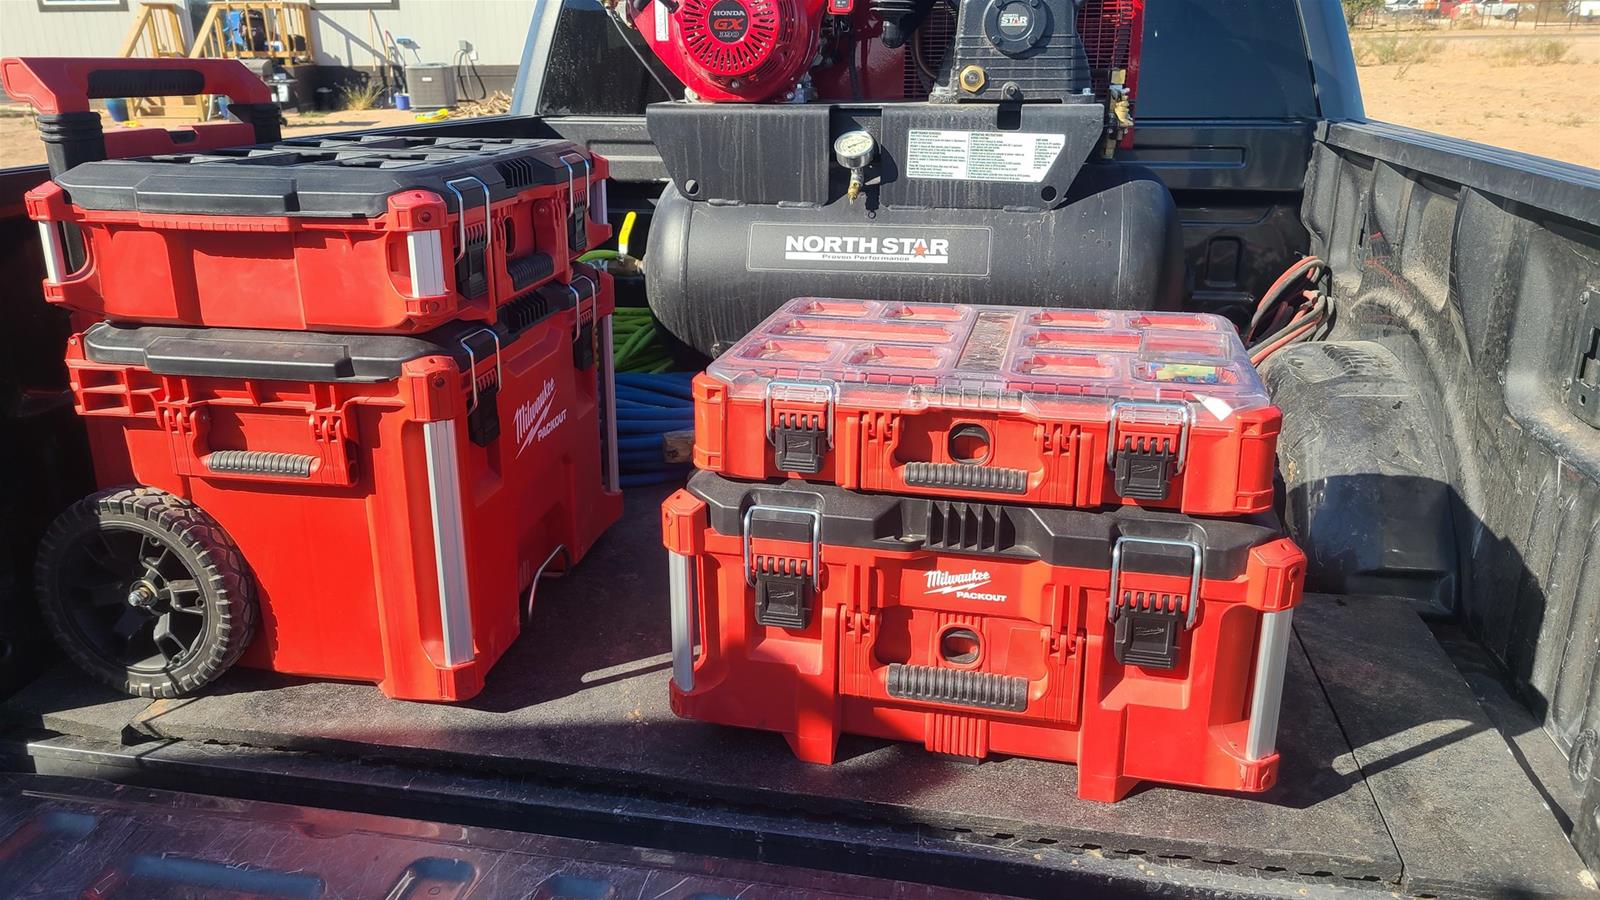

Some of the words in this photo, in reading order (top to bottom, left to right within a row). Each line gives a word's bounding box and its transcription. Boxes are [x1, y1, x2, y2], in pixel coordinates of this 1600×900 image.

[713, 18, 744, 31] GX
[1001, 16, 1027, 24] STAR
[512, 377, 555, 444] Milwaukee
[537, 408, 567, 442] PACKOUT
[923, 569, 990, 588] Milwaukee
[956, 591, 1007, 602] PACKOUT
